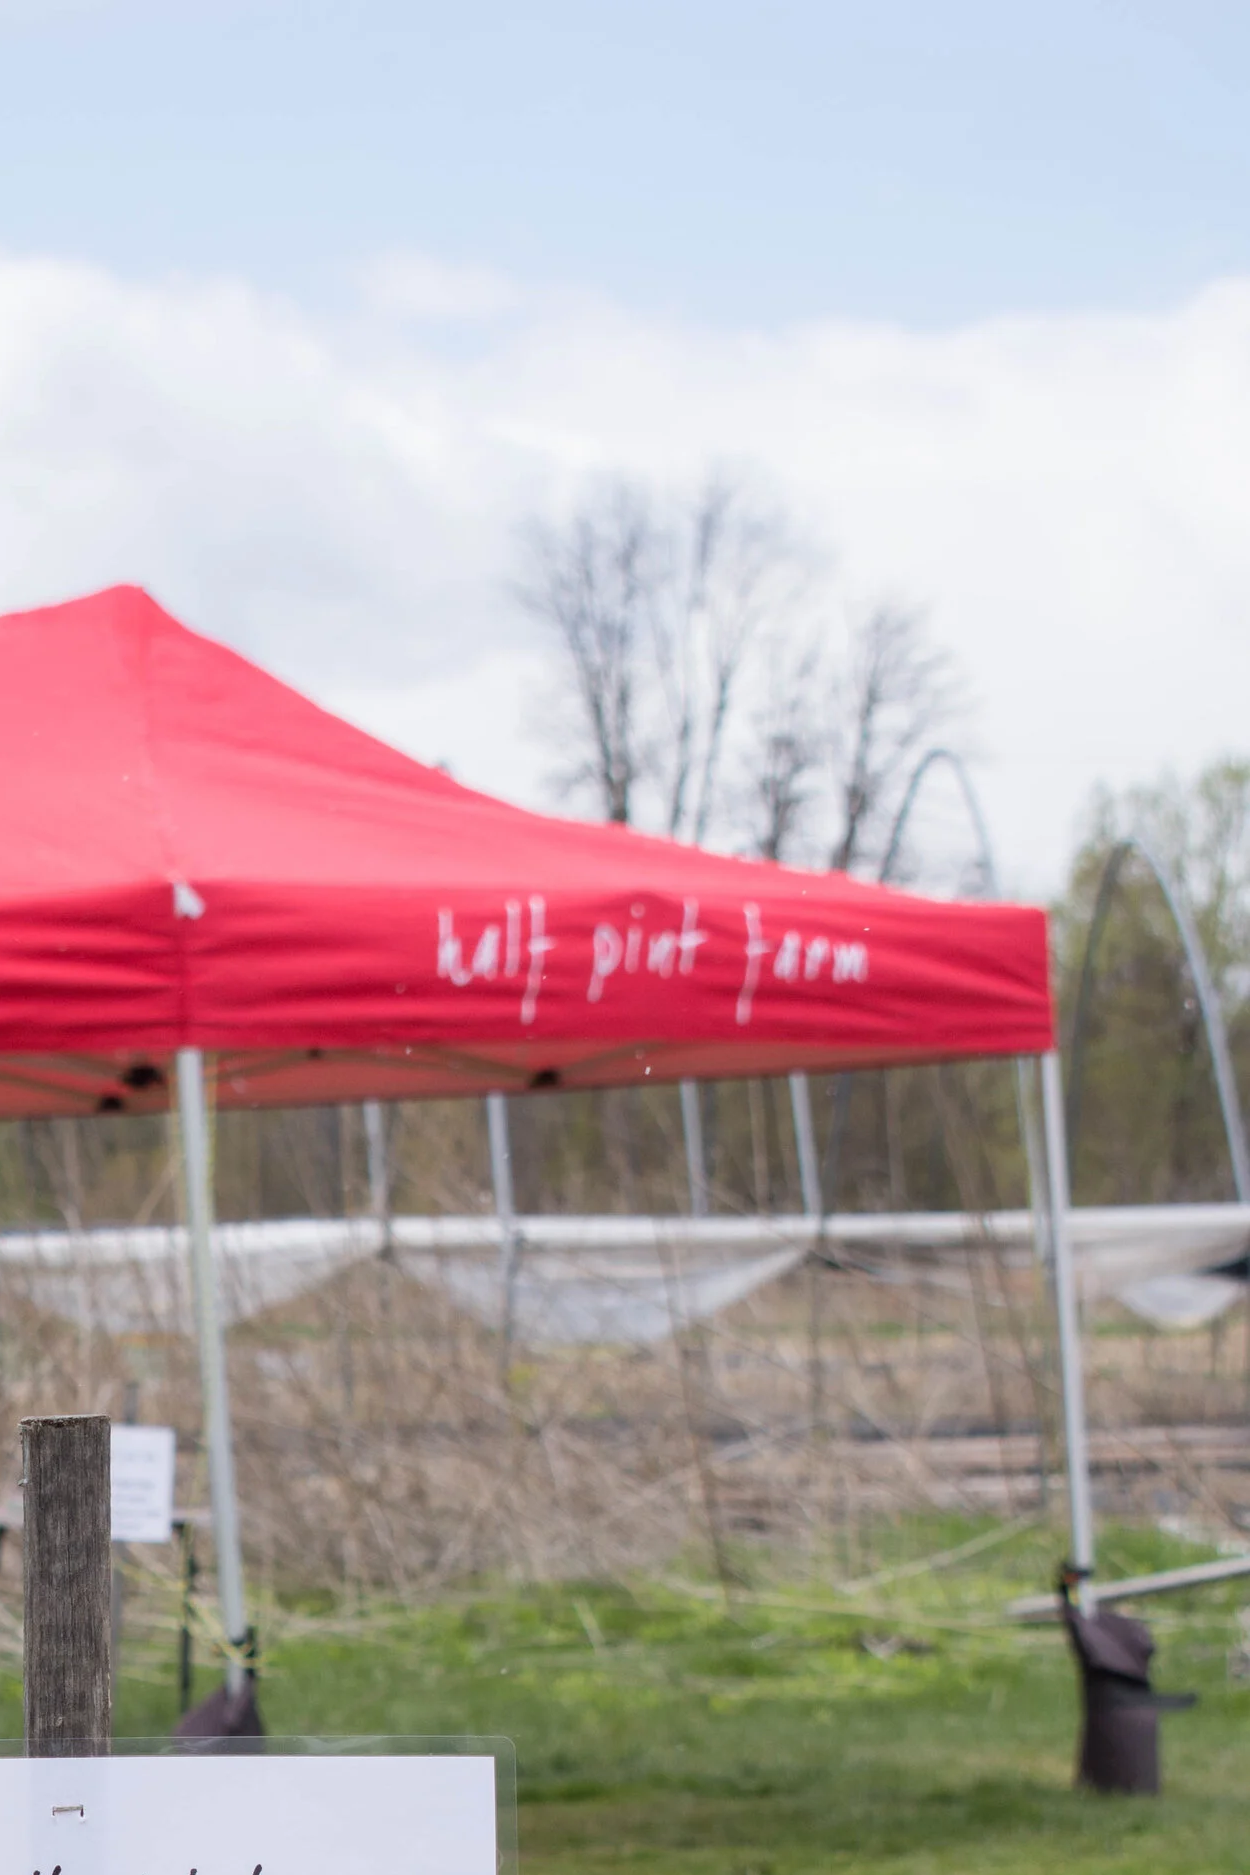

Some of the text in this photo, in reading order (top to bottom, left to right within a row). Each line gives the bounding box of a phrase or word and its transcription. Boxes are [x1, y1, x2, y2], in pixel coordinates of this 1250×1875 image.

[436, 893, 868, 1026] half pint farm
